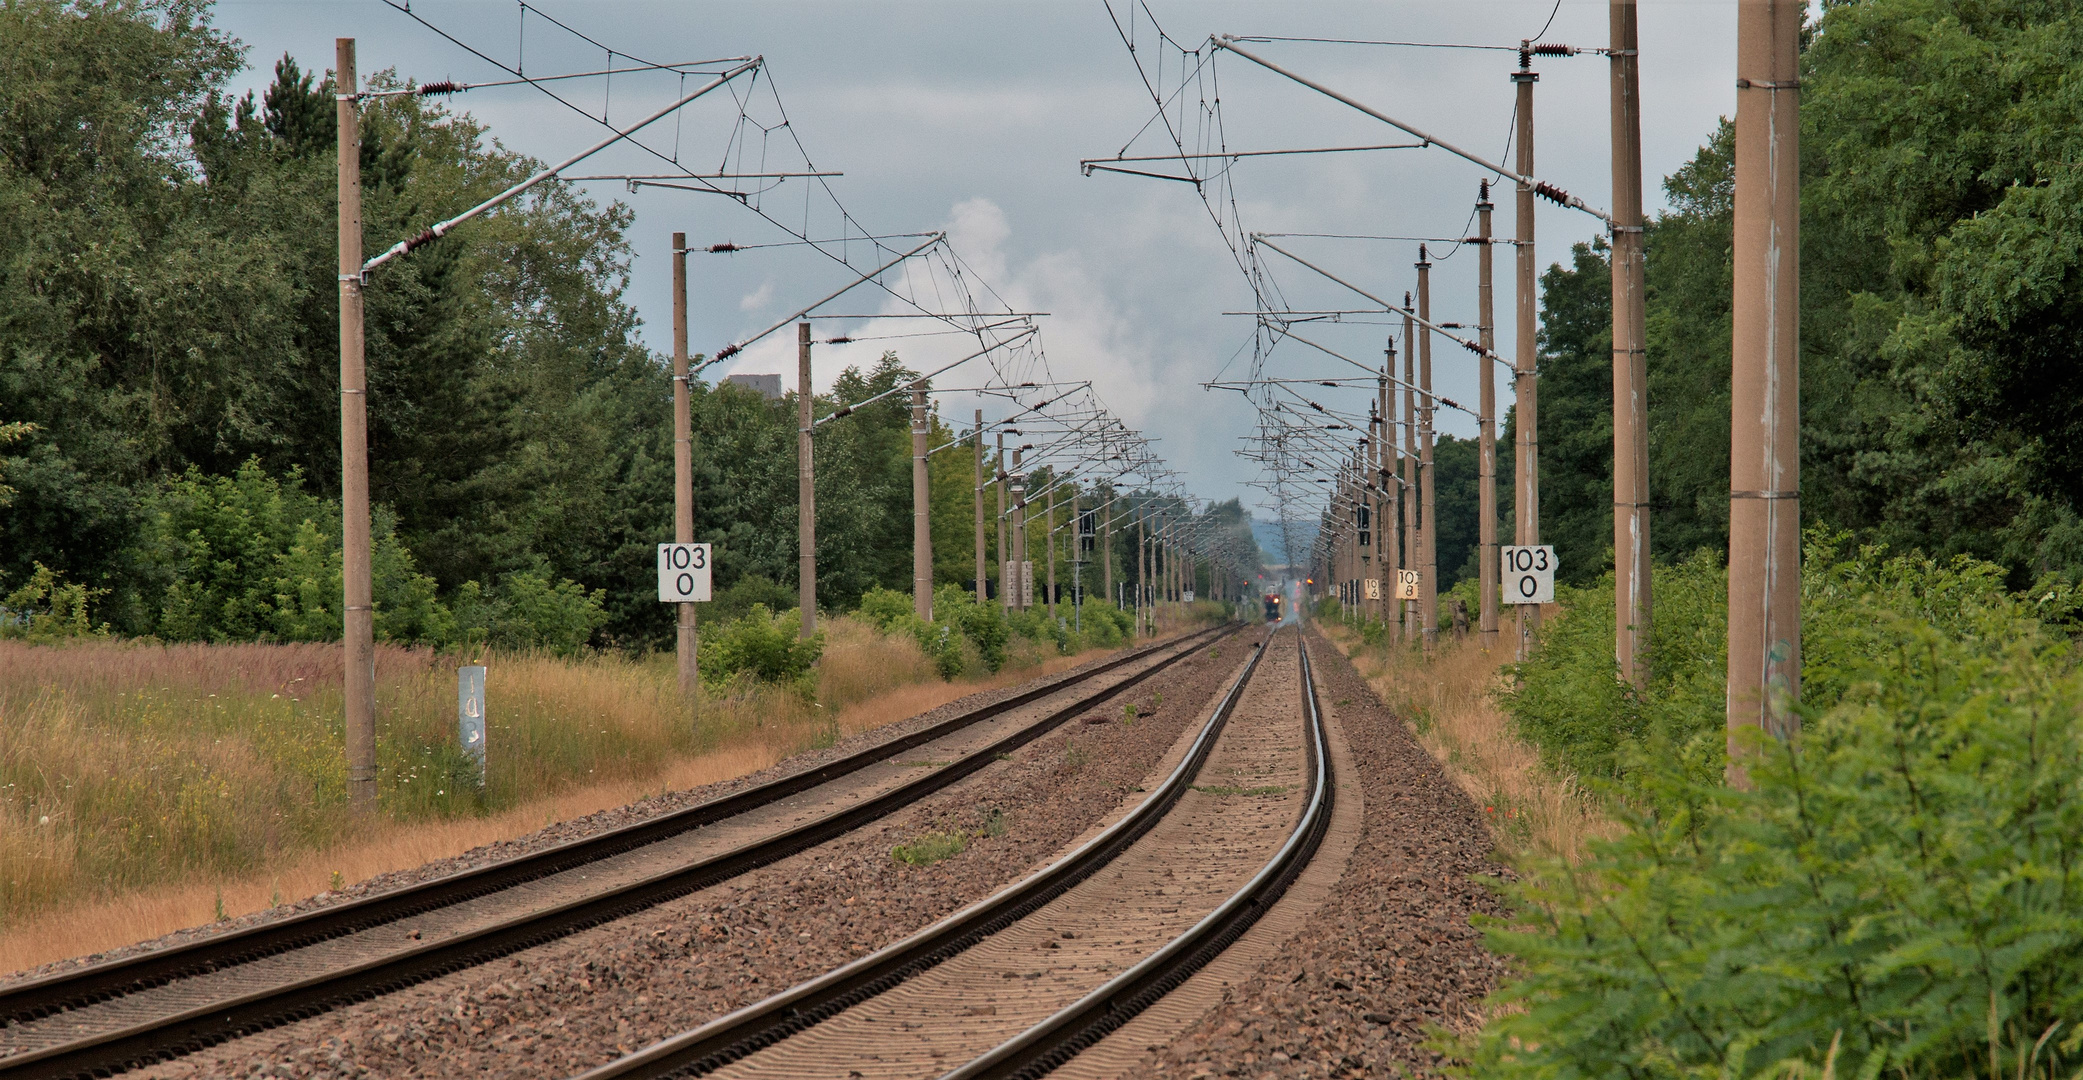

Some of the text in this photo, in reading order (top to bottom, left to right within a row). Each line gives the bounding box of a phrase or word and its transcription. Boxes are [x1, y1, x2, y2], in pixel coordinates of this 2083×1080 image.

[663, 546, 706, 570] 103
[1506, 548, 1549, 572] 103
[676, 572, 694, 596] 0
[1399, 571, 1418, 584] 10
[1519, 575, 1537, 598] 0
[1371, 589, 1378, 598] 6
[1405, 585, 1414, 597] 8
